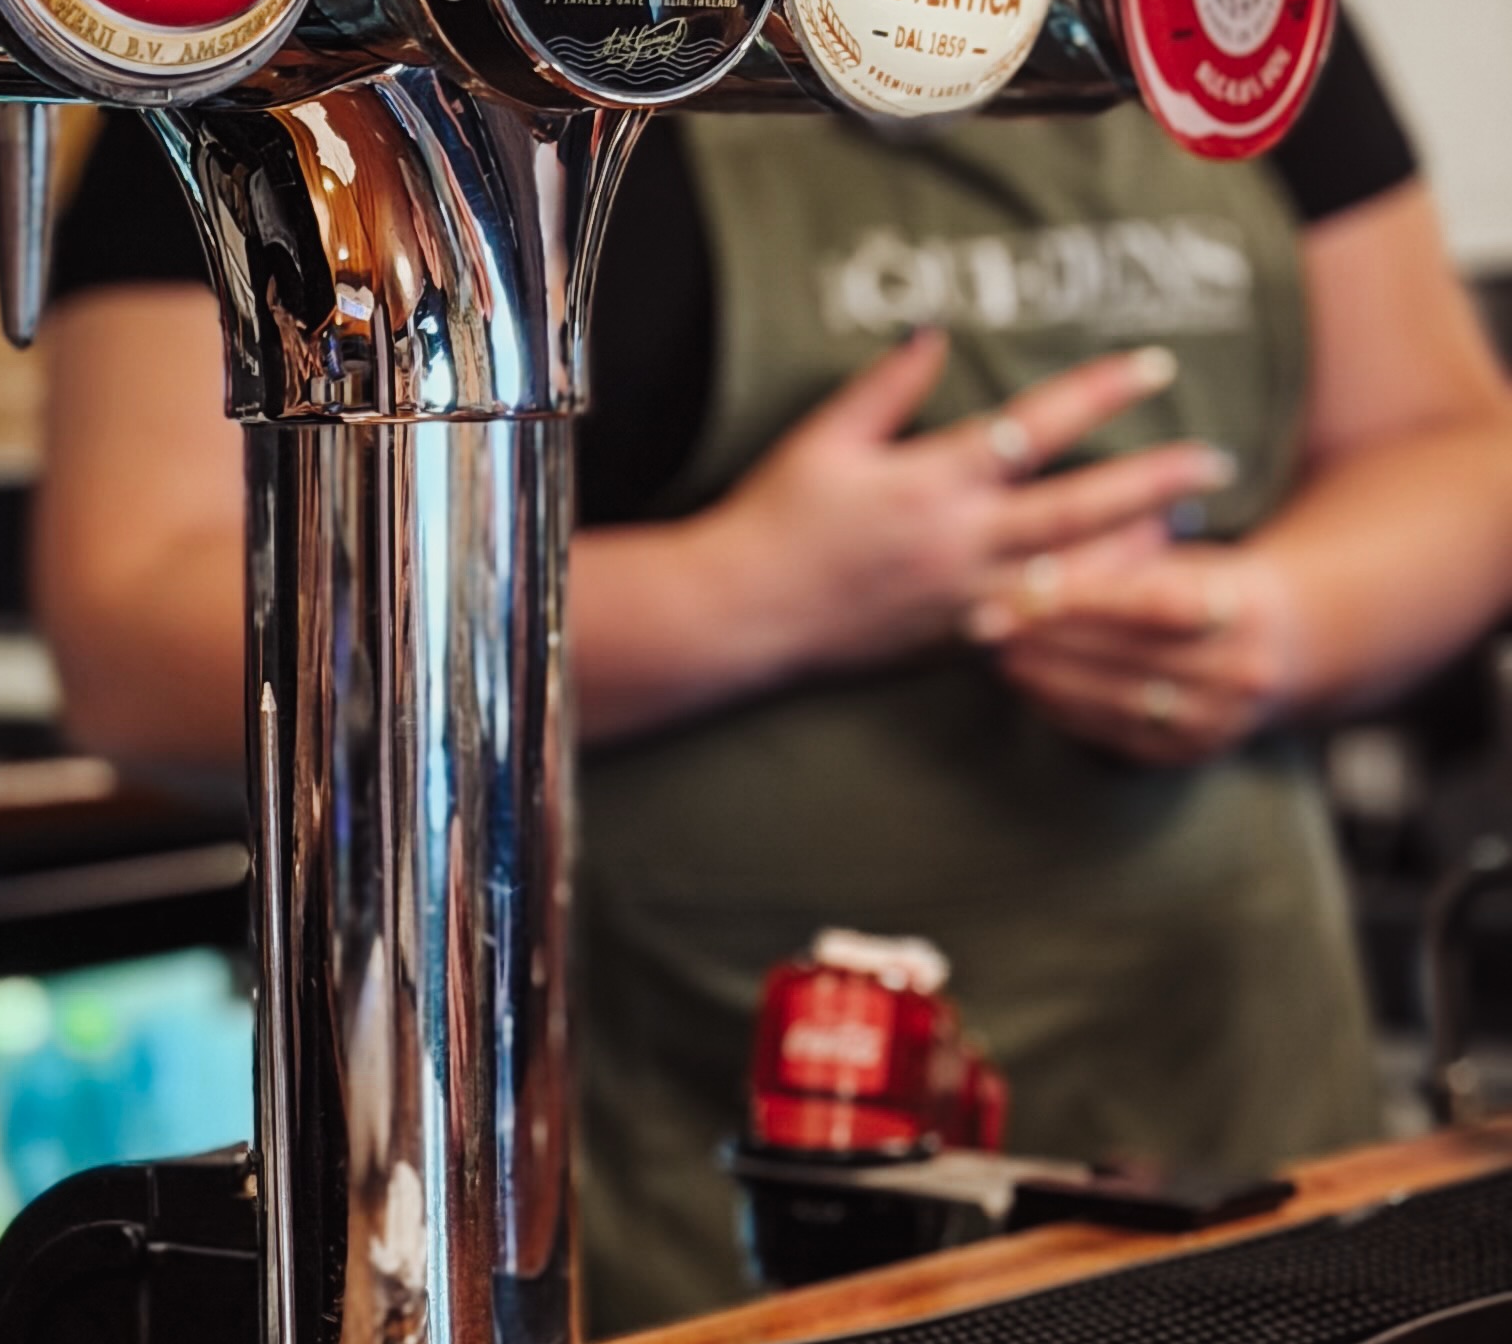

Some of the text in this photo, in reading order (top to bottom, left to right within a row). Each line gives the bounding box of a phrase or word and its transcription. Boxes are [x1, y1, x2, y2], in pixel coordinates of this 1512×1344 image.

[893, 24, 968, 59] DAL 1859
[867, 64, 923, 97] PREMIUM
